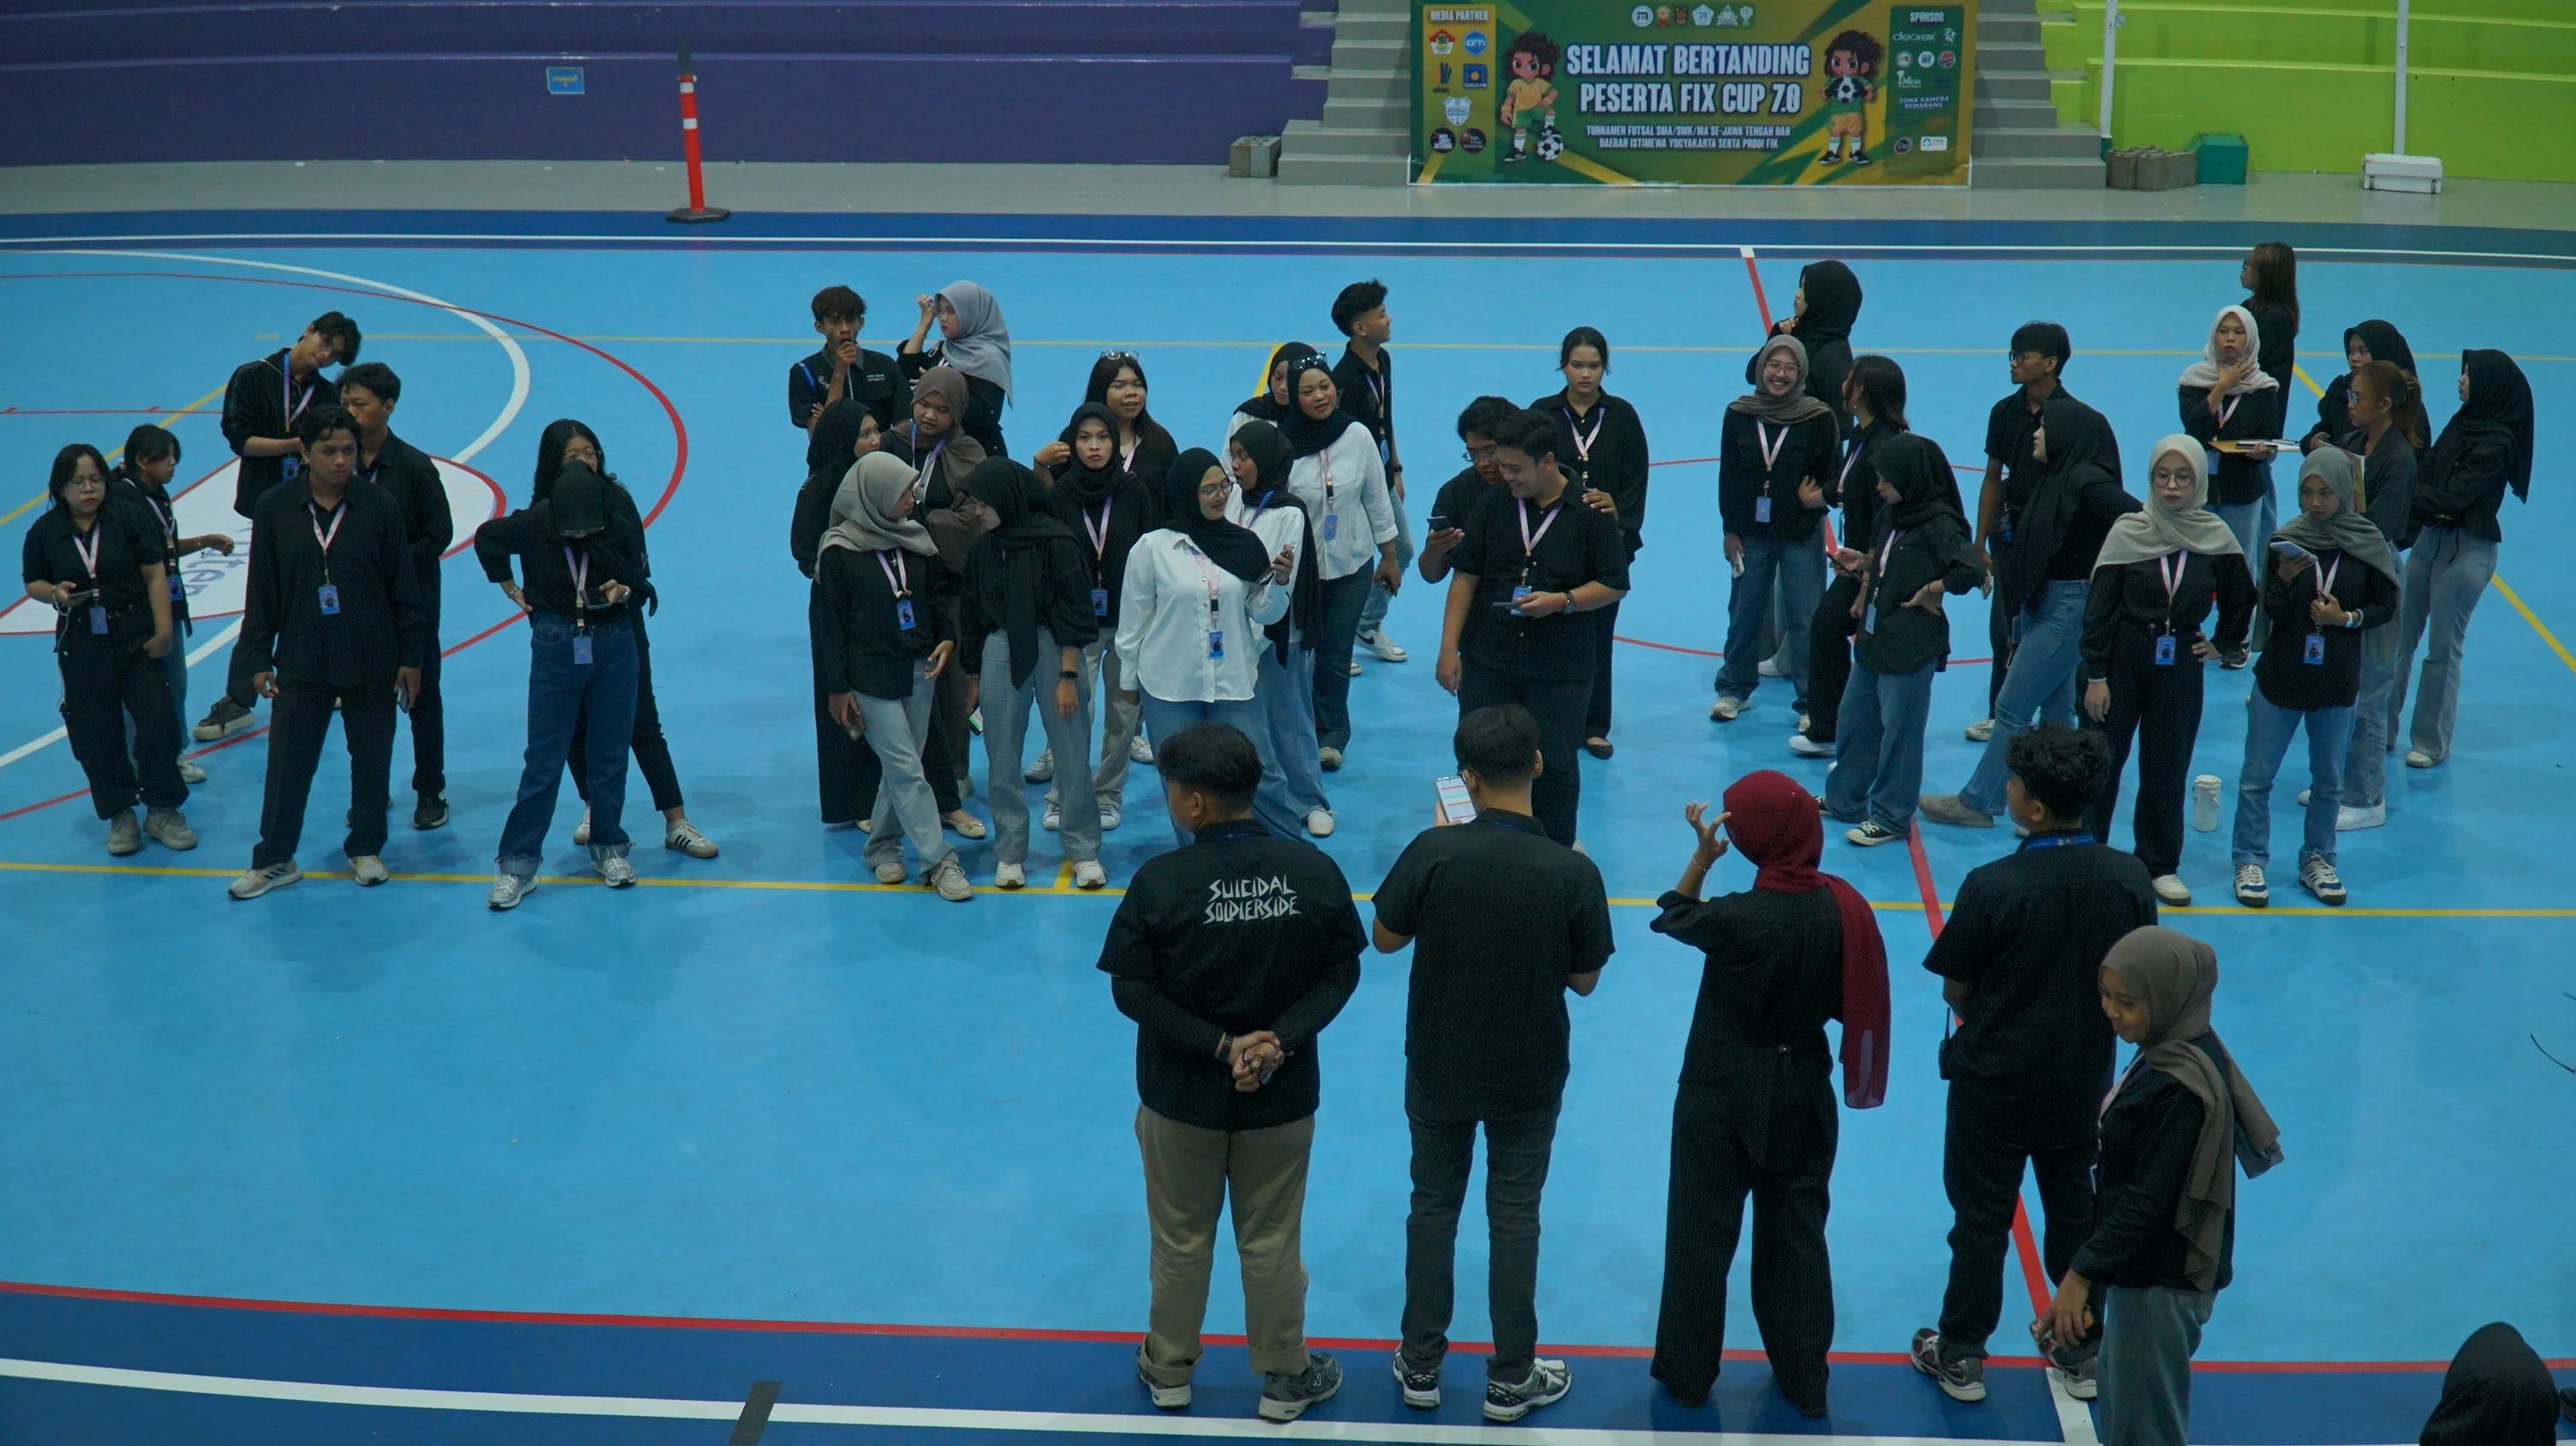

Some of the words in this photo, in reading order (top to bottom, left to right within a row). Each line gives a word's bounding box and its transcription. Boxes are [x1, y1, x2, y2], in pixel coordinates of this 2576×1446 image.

[1430, 10, 1453, 21] MEDIA
[1455, 10, 1488, 21] PARTNER
[1910, 12, 1944, 23] SPONSOR
[1566, 45, 1667, 75] SELAMAT
[1673, 45, 1810, 75] BERTANDING
[1580, 83, 1674, 113] PESERTA
[1680, 83, 1716, 113] FIX
[1721, 83, 1766, 113] CUP
[1770, 83, 1801, 113] 7.0
[1586, 125, 1626, 136] TURNAMEN
[1627, 125, 1655, 136] FUTSAL
[1656, 125, 1708, 136] SMA/SMK/MA
[1710, 125, 1744, 136] SE-JAWA
[1745, 125, 1774, 136] TENGAH
[1774, 126, 1792, 136] DAN
[1599, 138, 1629, 148] DAERAH
[1630, 138, 1667, 148] ISTIMEWA
[1669, 138, 1717, 148] YOGYAKARTA
[1718, 138, 1741, 148] SERTA
[1742, 138, 1765, 148] PRODI
[1766, 138, 1779, 148] FIK
[1208, 873, 1297, 903] SUICIDAL
[1202, 896, 1303, 925] SOLDIERSIDE
